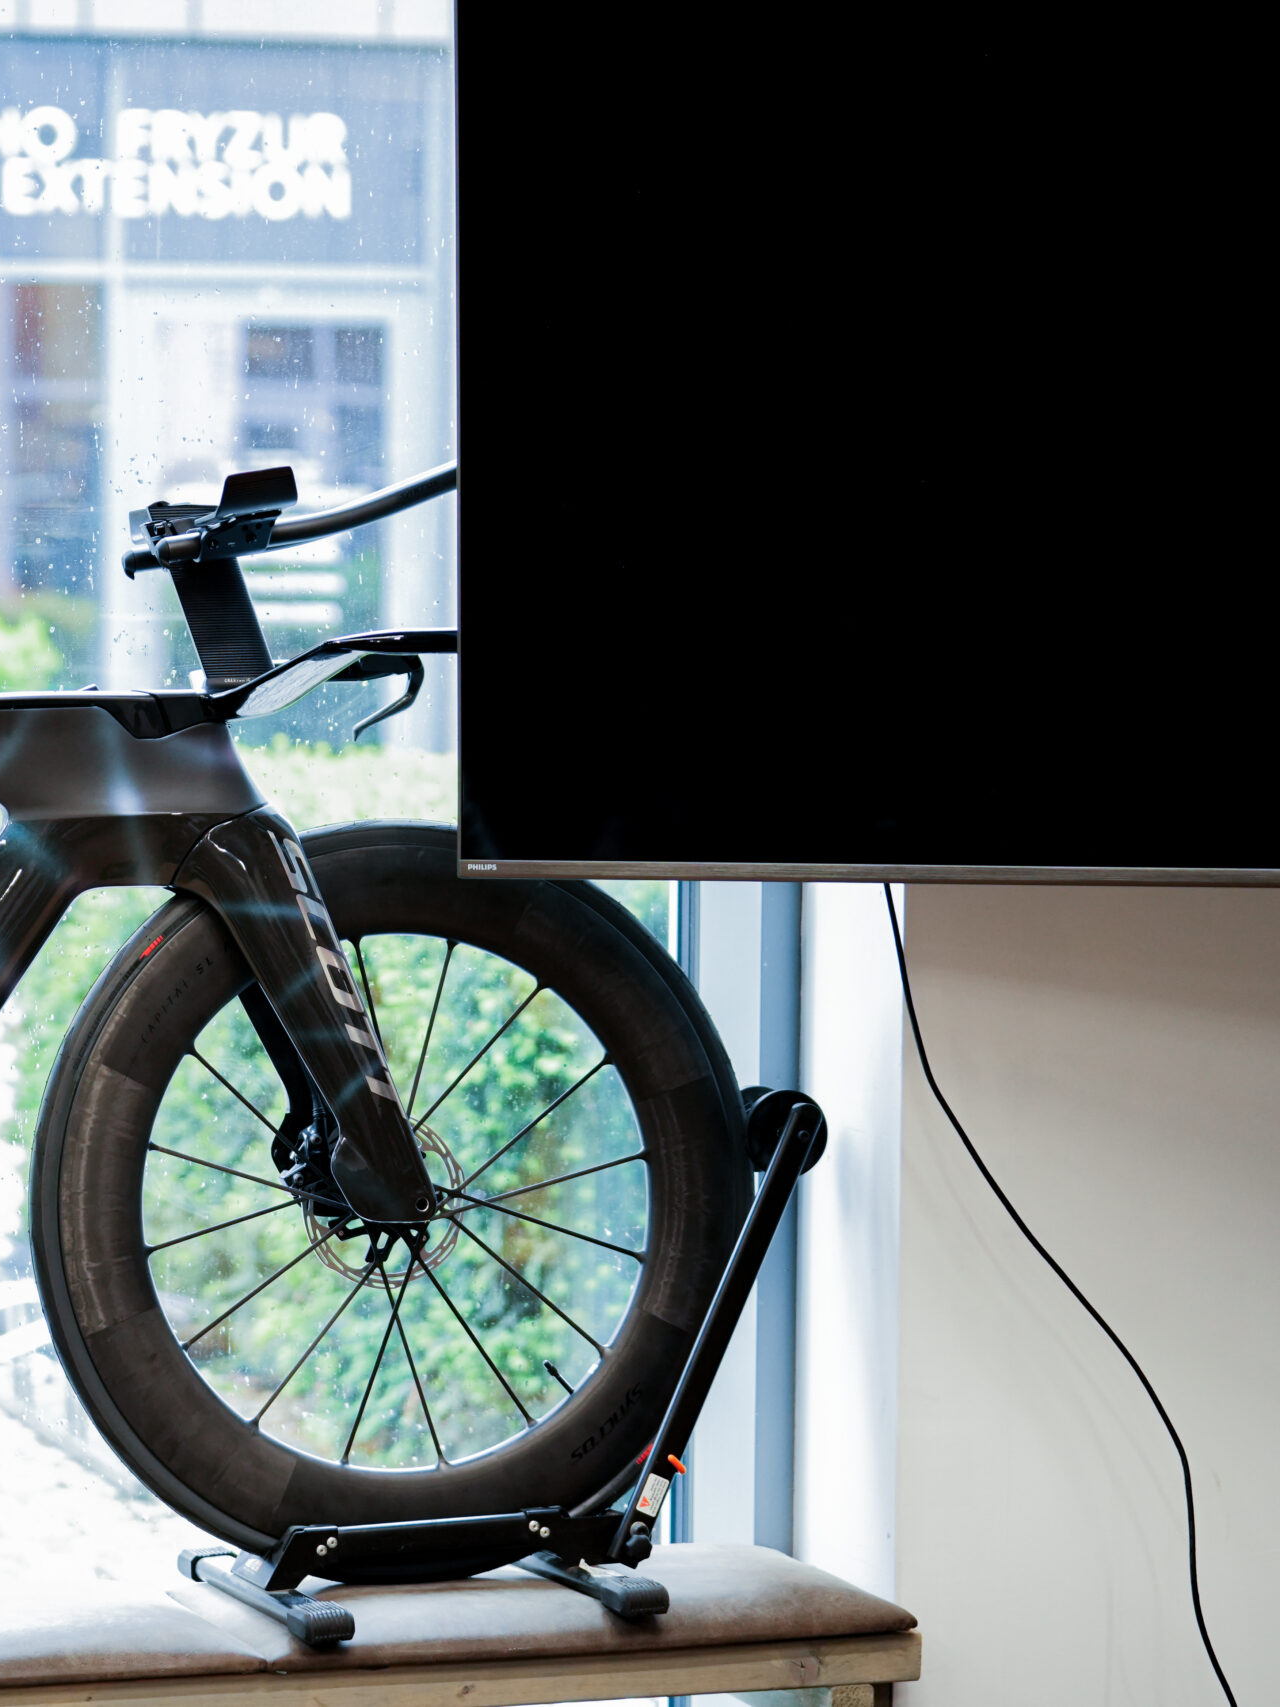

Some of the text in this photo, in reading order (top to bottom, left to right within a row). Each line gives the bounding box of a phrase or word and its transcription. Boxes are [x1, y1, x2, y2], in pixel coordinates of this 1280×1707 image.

[120, 108, 348, 170] FRYZUR
[1, 156, 353, 221] EXTENSION
[467, 863, 497, 872] PHILIPS
[267, 829, 407, 1119] SCOTT
